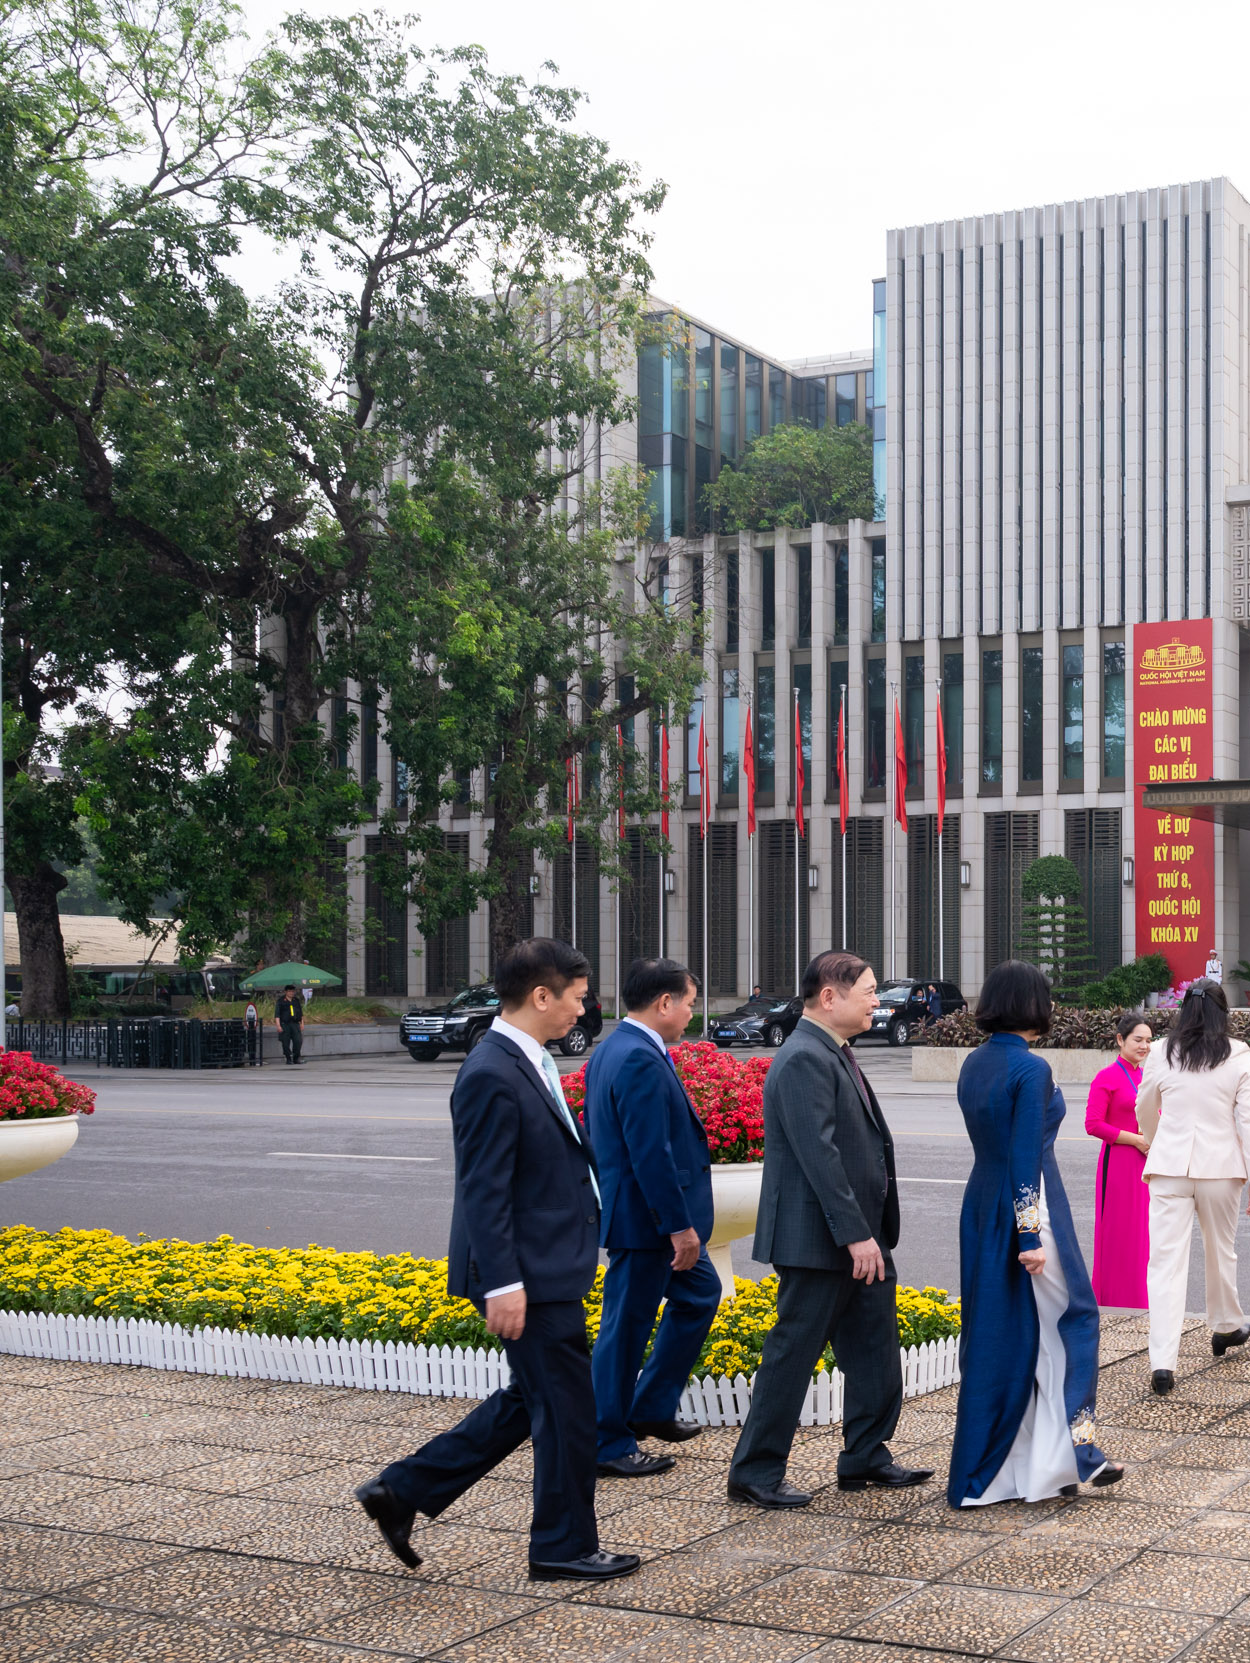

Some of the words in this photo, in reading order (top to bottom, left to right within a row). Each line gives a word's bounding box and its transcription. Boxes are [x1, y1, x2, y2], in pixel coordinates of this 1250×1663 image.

[1140, 672, 1158, 680] QUỐC
[1160, 671, 1171, 681] HỘI
[1172, 669, 1188, 678] VIỆT
[1140, 708, 1169, 727] CHÀO
[1173, 707, 1206, 725] MỪNG
[1155, 735, 1177, 753] CÁC
[1180, 737, 1190, 755] VỊ
[1150, 765, 1168, 783] ĐẠI
[1172, 758, 1196, 779] BIỂU
[1158, 814, 1171, 834] VỀ
[1175, 817, 1190, 836] DỰ
[1154, 843, 1168, 861] KỲ
[1172, 846, 1194, 864] HỌP
[1157, 870, 1179, 888] THỨ
[1182, 873, 1191, 889] 8,
[1149, 895, 1178, 917] QUỐC
[1182, 897, 1200, 918] HỘI
[1151, 924, 1181, 942] KHÓA
[1184, 927, 1198, 942] XV
